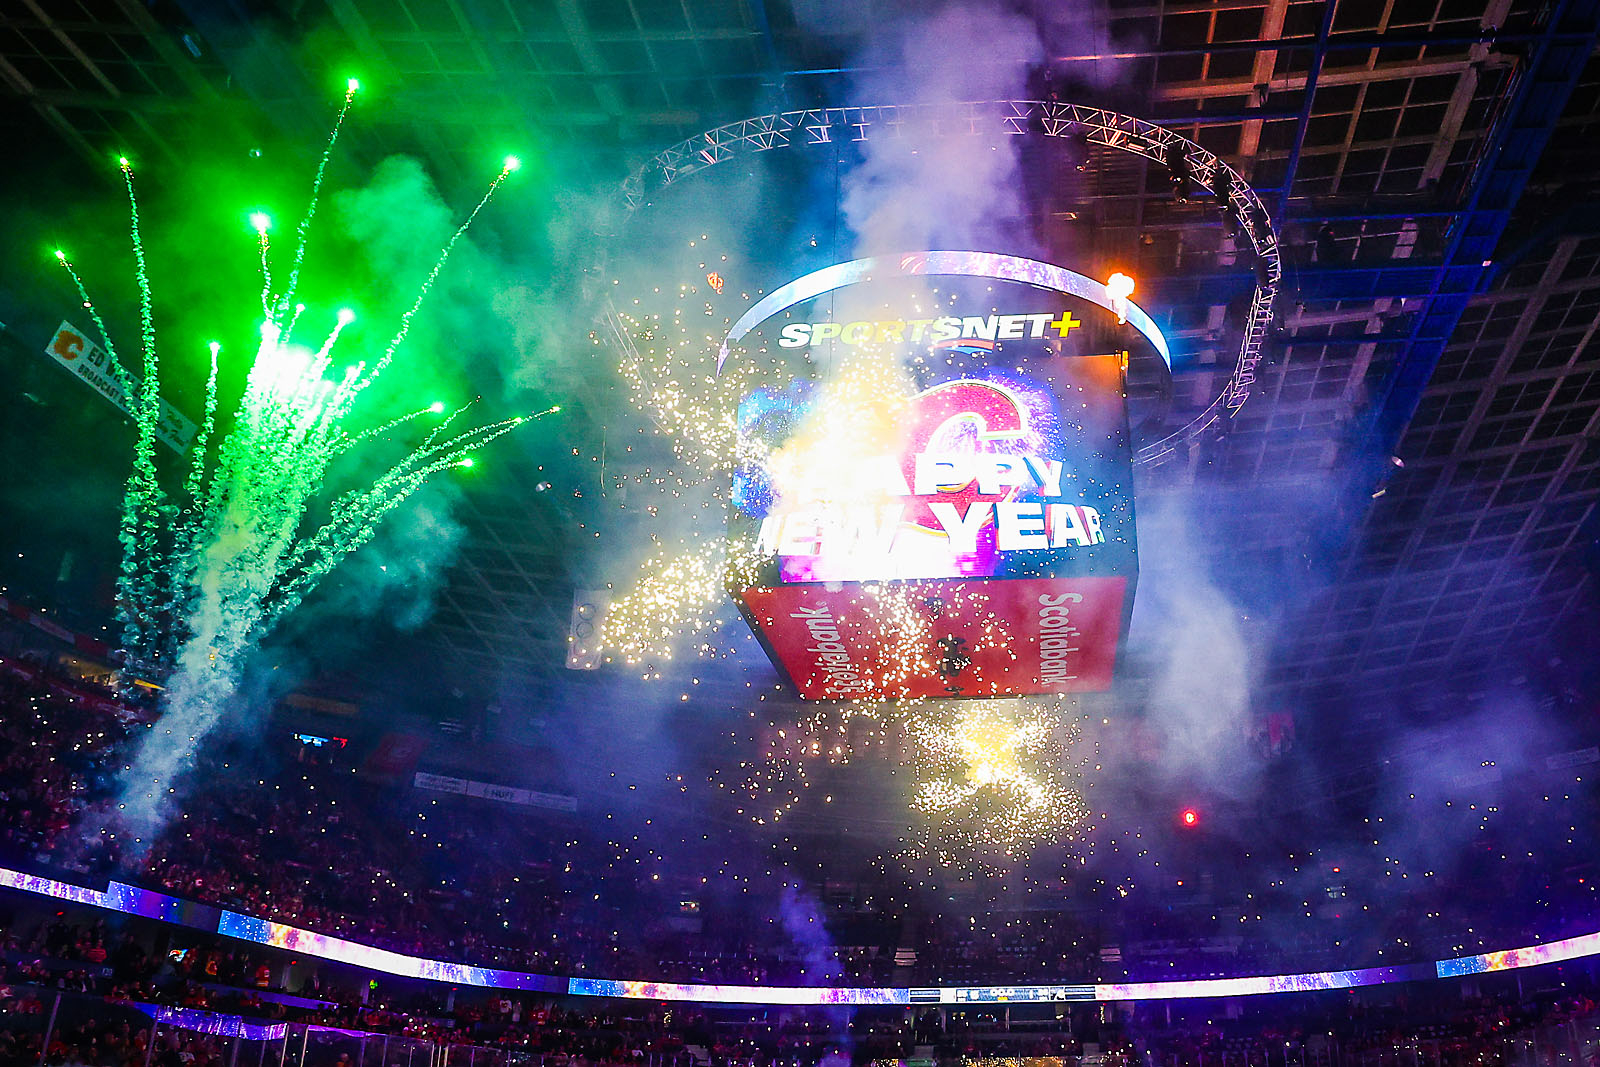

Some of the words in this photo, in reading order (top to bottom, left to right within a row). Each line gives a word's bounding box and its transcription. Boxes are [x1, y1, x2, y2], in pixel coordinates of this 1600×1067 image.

[77, 364, 120, 399] BROADCAST
[87, 346, 105, 368] ED
[928, 501, 1104, 553] YEAR
[790, 605, 869, 694] Scotiabank
[1038, 592, 1083, 687] Scotiabank
